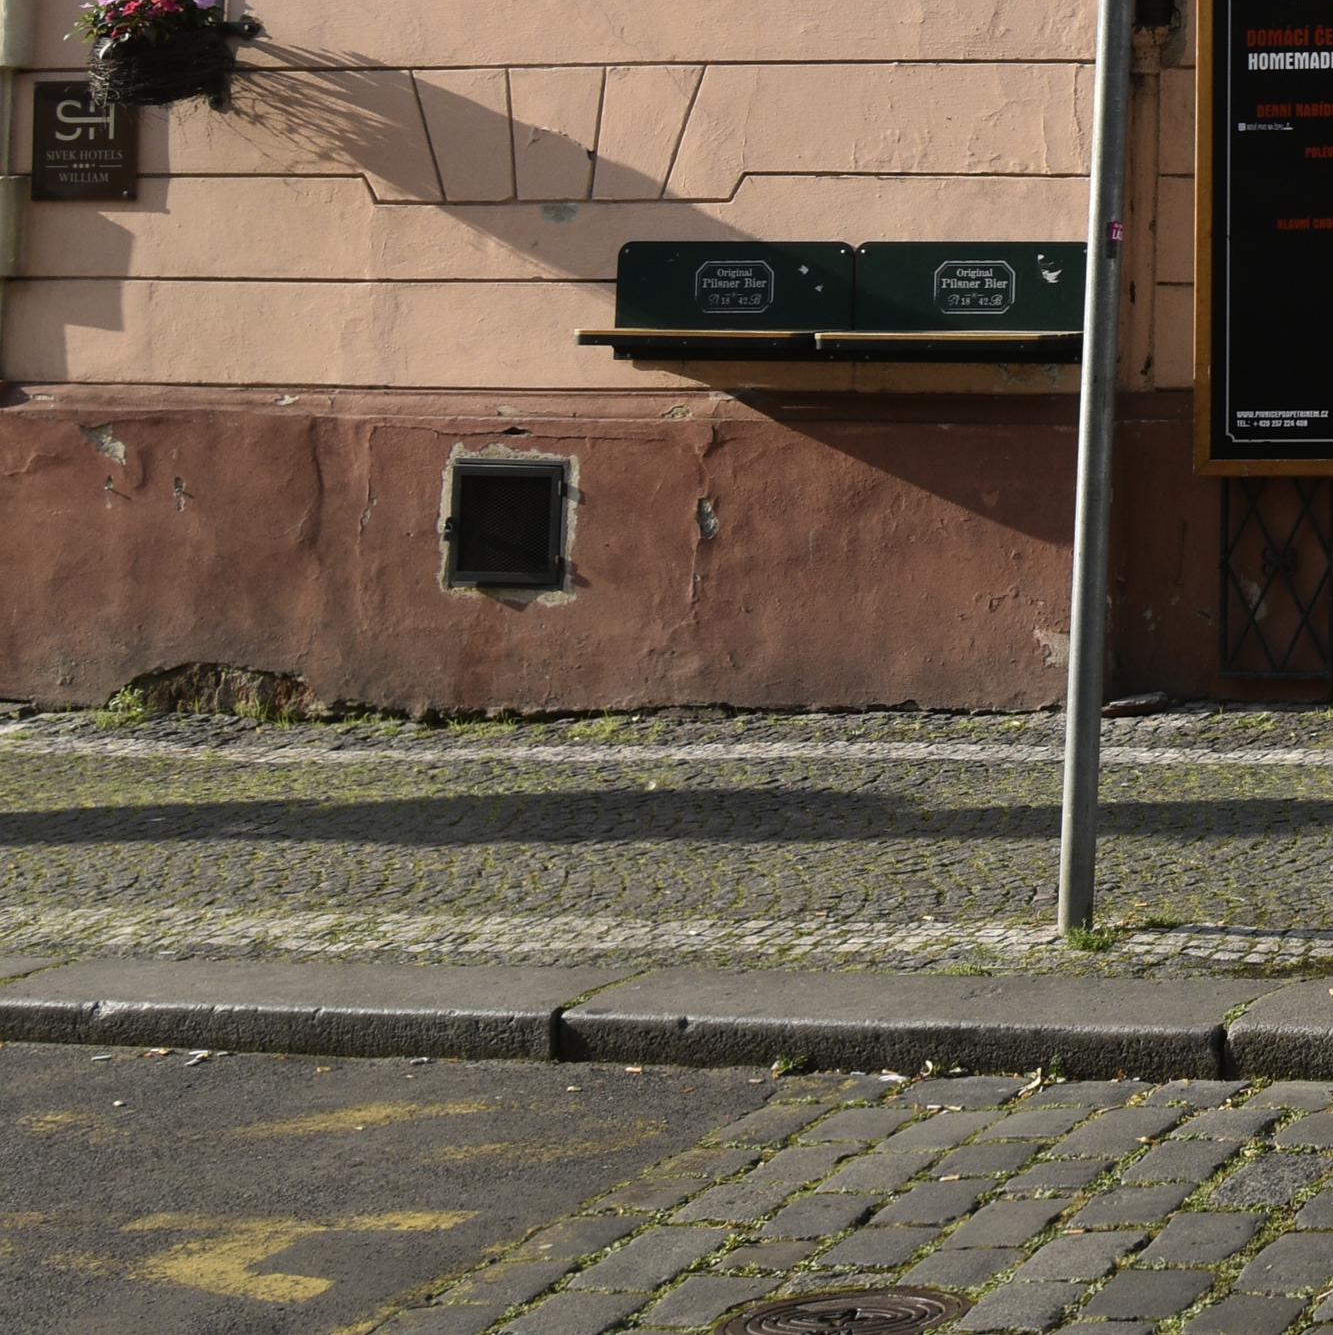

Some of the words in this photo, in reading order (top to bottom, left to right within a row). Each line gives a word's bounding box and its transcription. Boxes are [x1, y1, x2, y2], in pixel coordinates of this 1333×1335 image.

[45, 150, 76, 160] SIVEK
[80, 149, 123, 160] HOTELS
[58, 173, 109, 183] WILLIAM
[716, 268, 753, 279] Original
[956, 268, 993, 279] Original
[702, 278, 741, 288] Pilsner
[743, 277, 767, 288] Bier
[941, 278, 981, 289] Pilsner
[984, 278, 1008, 289] Bier
[960, 297, 971, 306] 18
